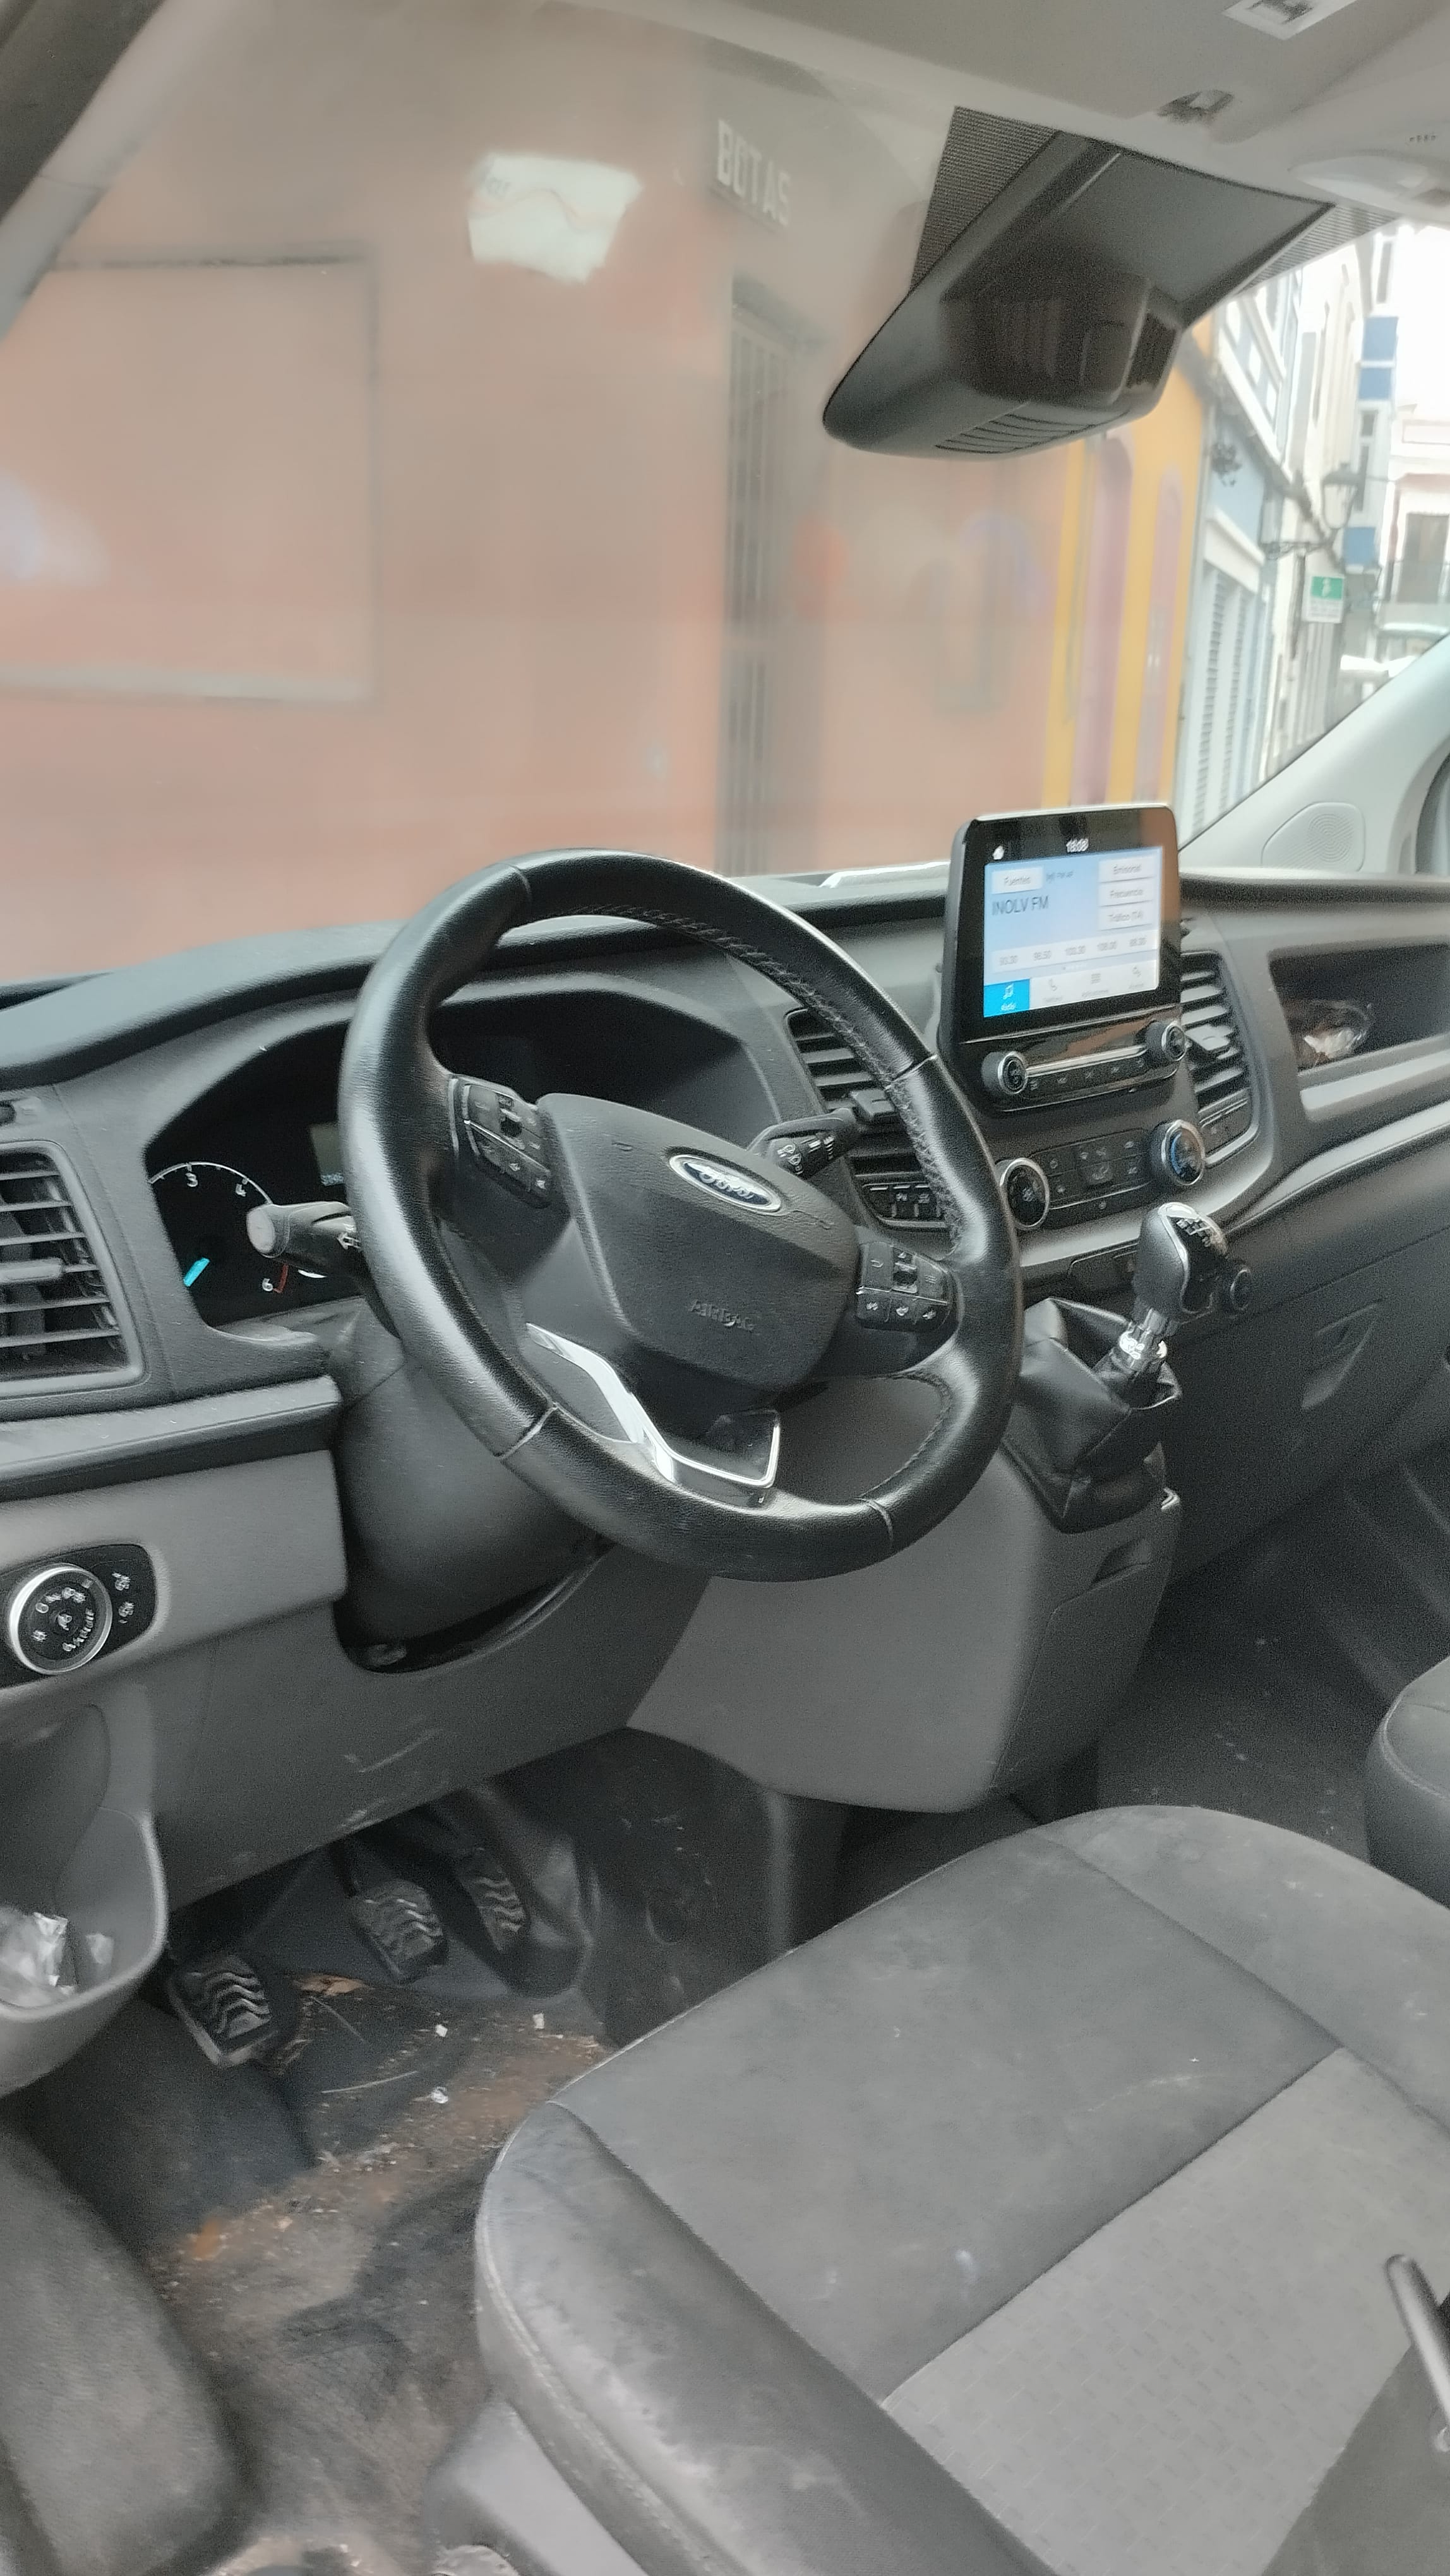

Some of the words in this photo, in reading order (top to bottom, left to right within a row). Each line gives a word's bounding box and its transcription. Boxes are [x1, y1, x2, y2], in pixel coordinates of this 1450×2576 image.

[717, 118, 790, 227] BOTAS
[992, 897, 1029, 915] INOLV
[1031, 895, 1049, 911] FM
[185, 1172, 198, 1187] 3
[261, 1277, 274, 1292] 6
